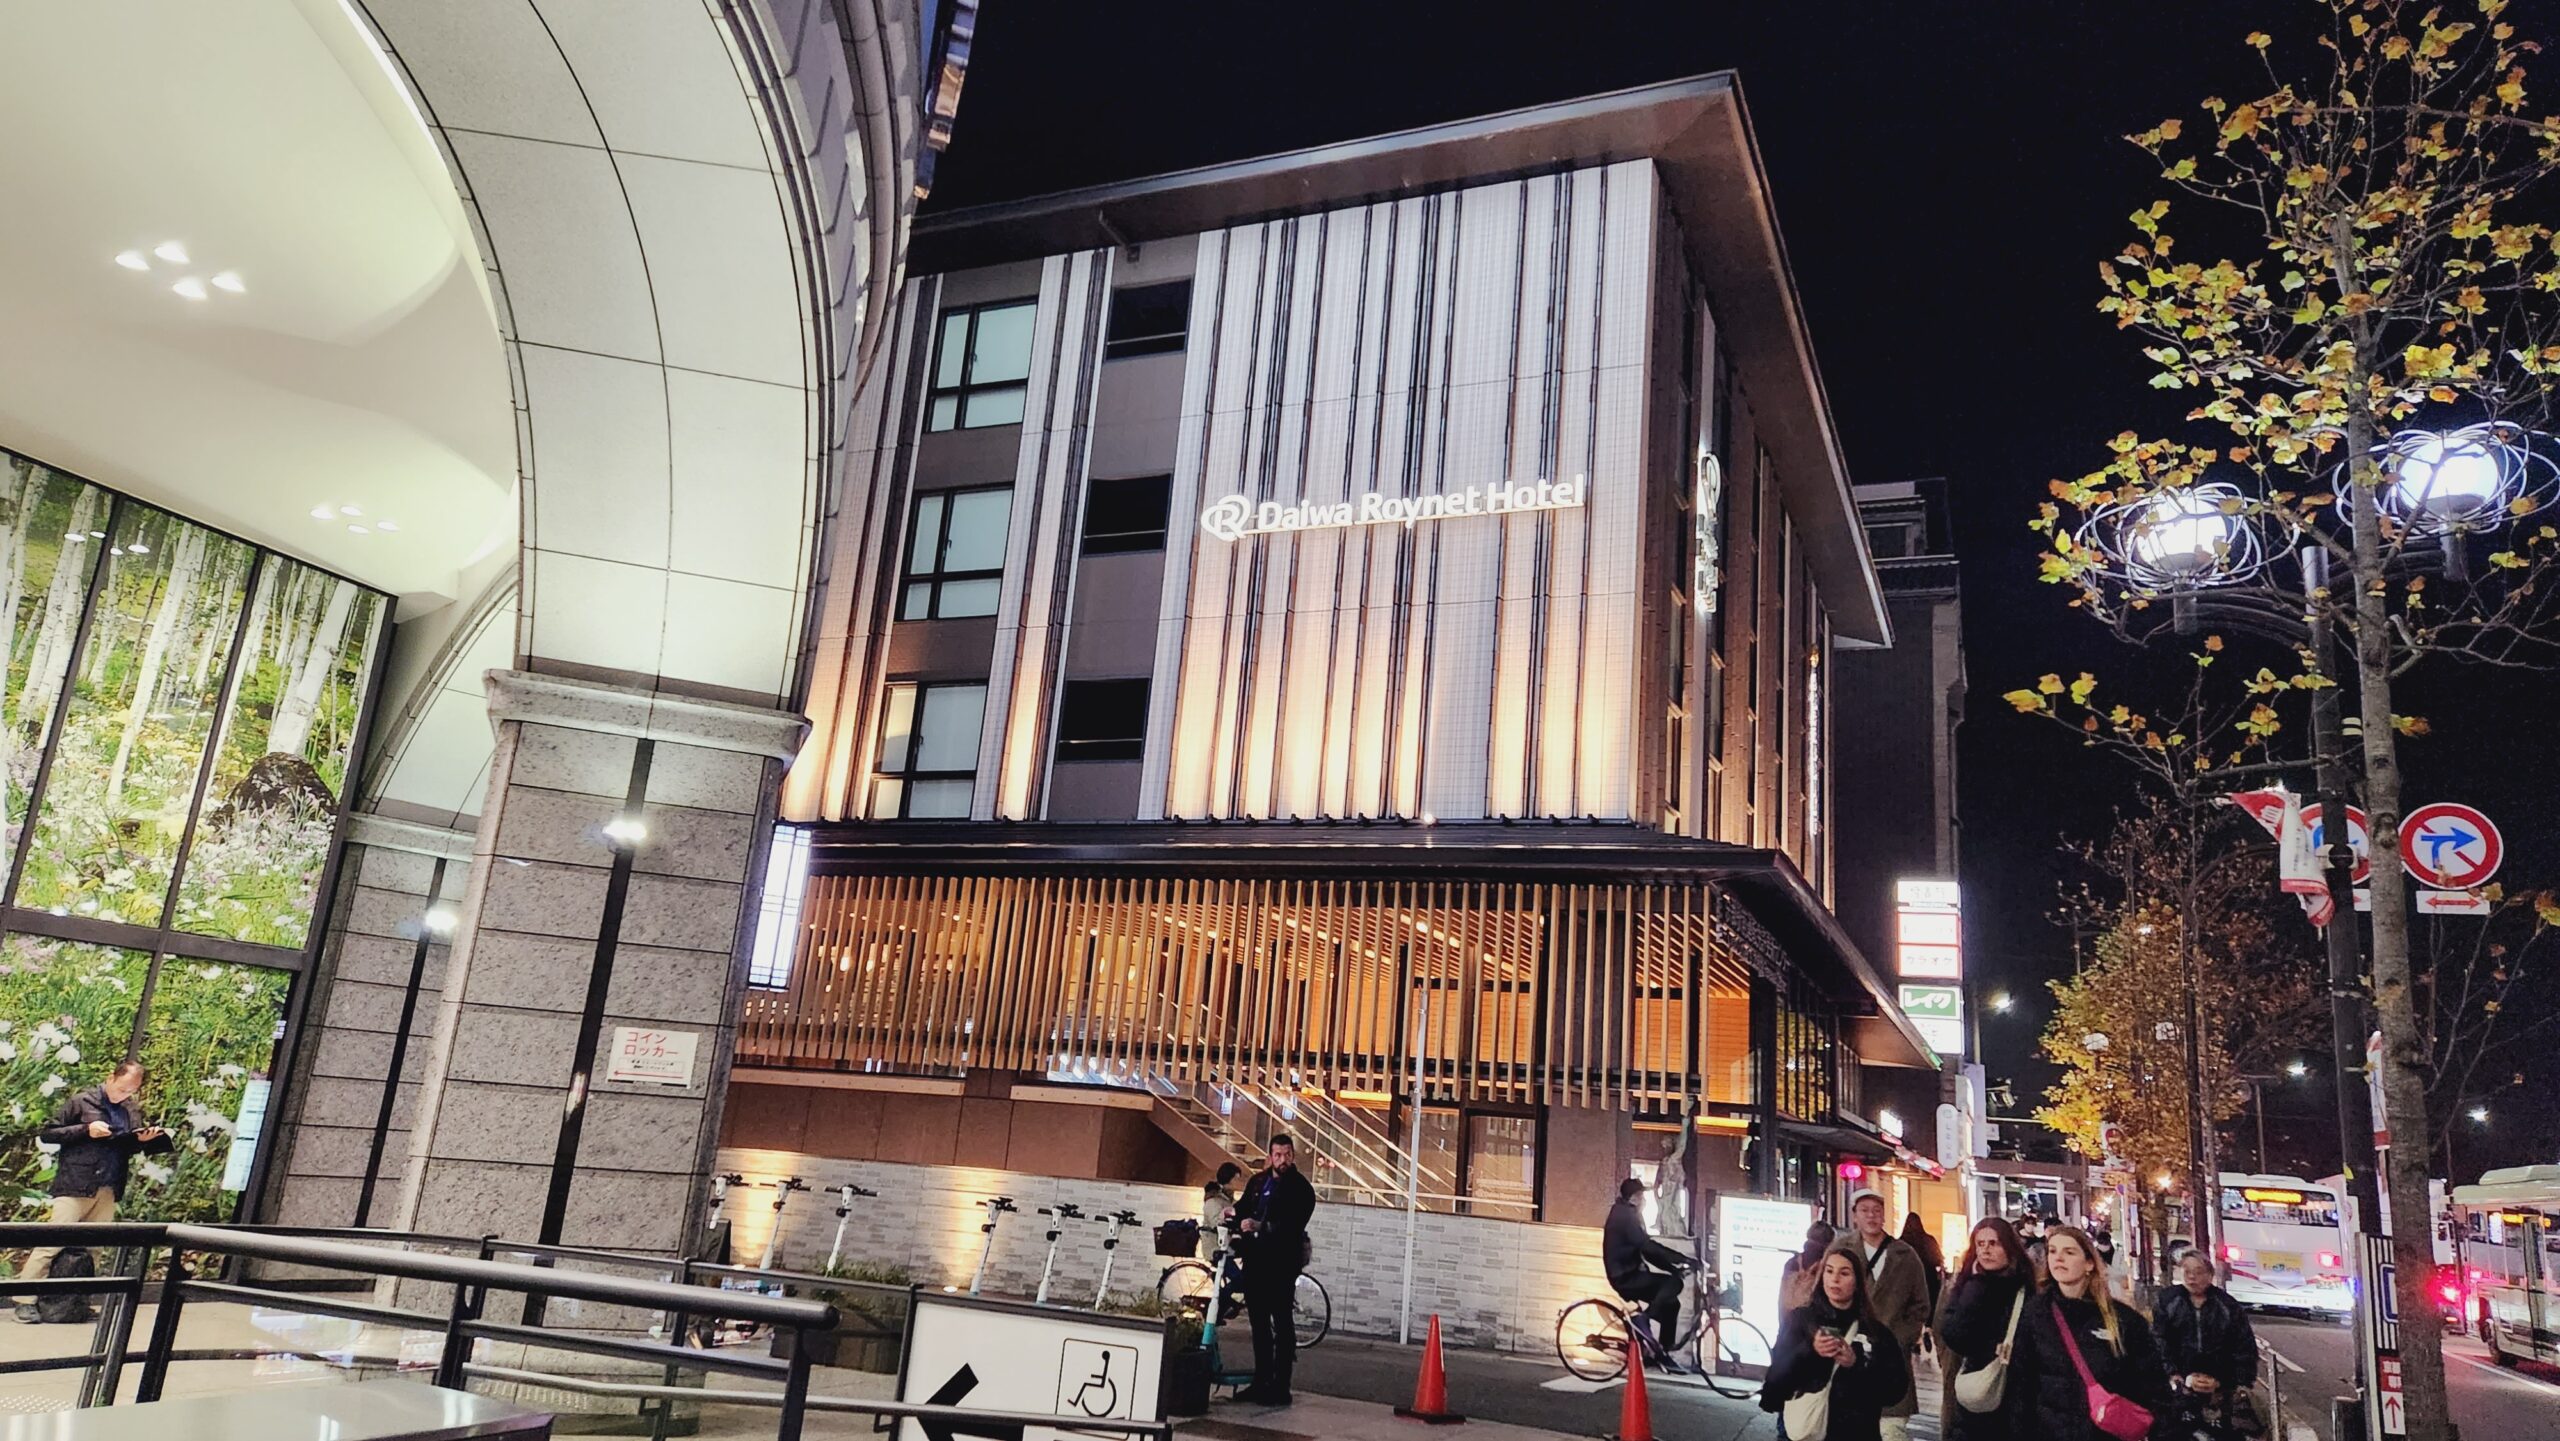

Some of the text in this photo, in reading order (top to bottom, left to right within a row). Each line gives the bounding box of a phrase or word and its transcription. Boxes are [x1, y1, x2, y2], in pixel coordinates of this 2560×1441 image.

[1258, 499, 1353, 530] Daiwa
[1360, 485, 1481, 528] Roynet
[1487, 474, 1585, 513] Hotel
[1904, 991, 1952, 1009] レイク
[626, 1031, 667, 1044] コイン
[624, 1044, 679, 1058] ロッカー
